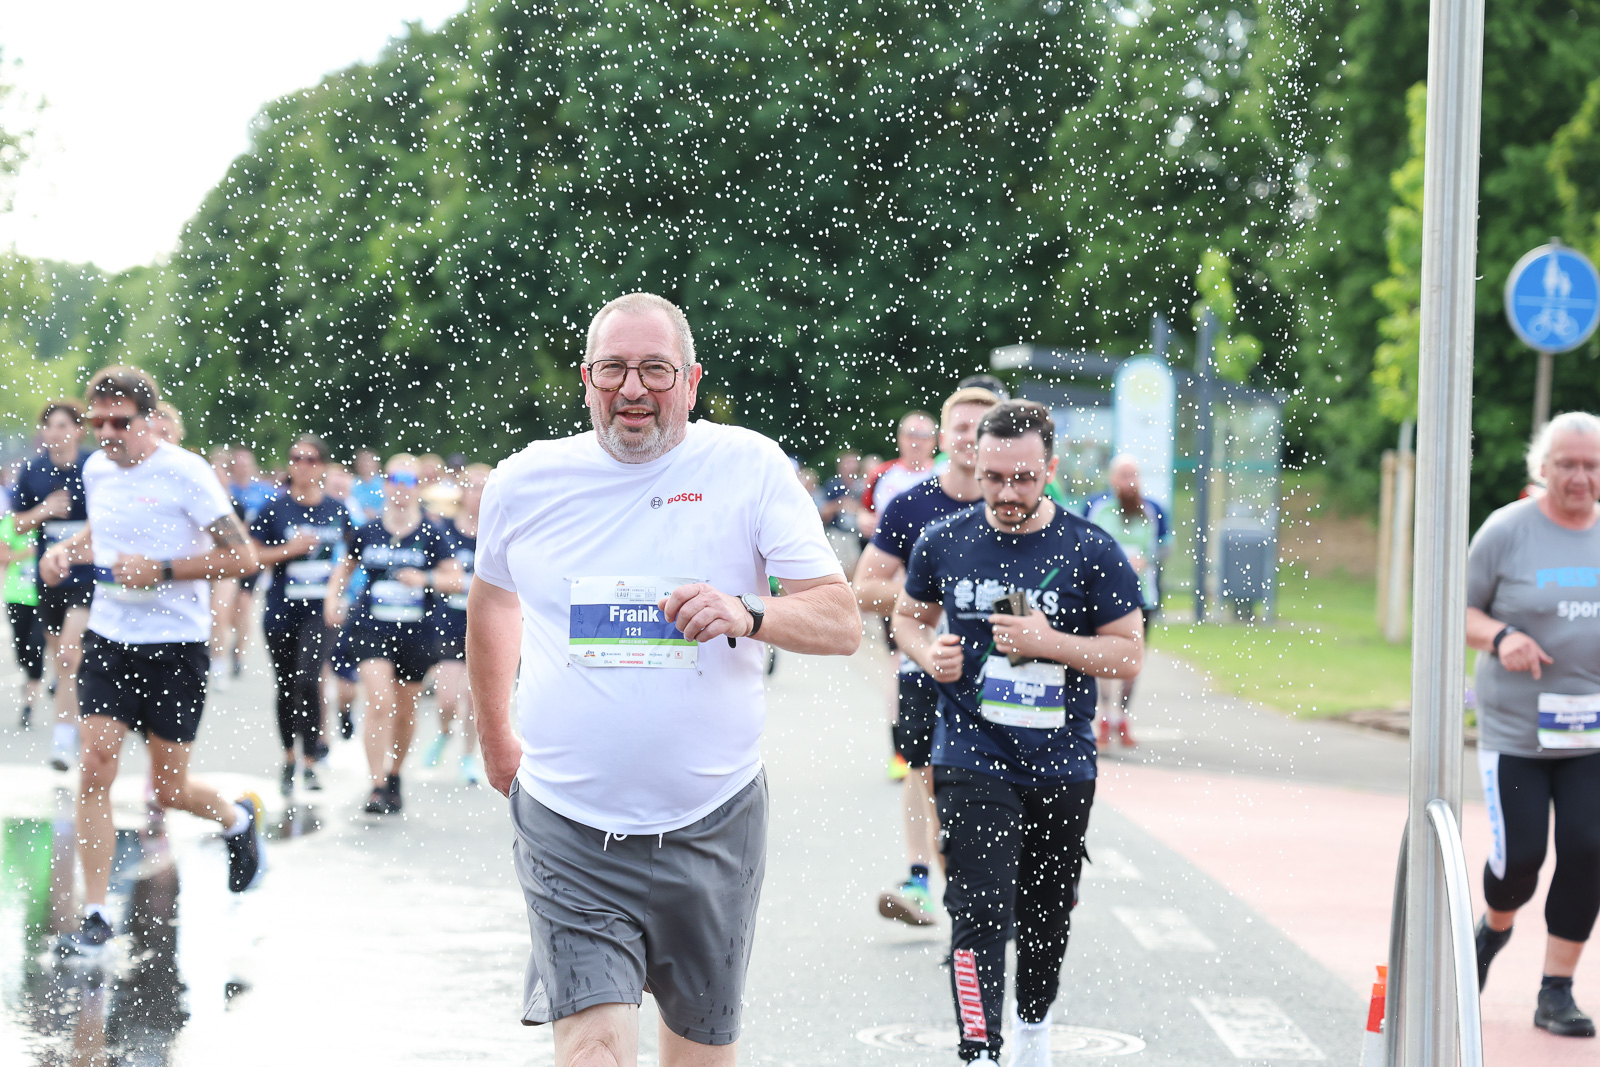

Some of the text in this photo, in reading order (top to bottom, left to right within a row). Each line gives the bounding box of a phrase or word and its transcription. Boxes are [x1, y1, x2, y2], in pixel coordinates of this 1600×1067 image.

[667, 493, 703, 504] BOSCH
[609, 605, 659, 622] Frank
[625, 627, 642, 636] 121
